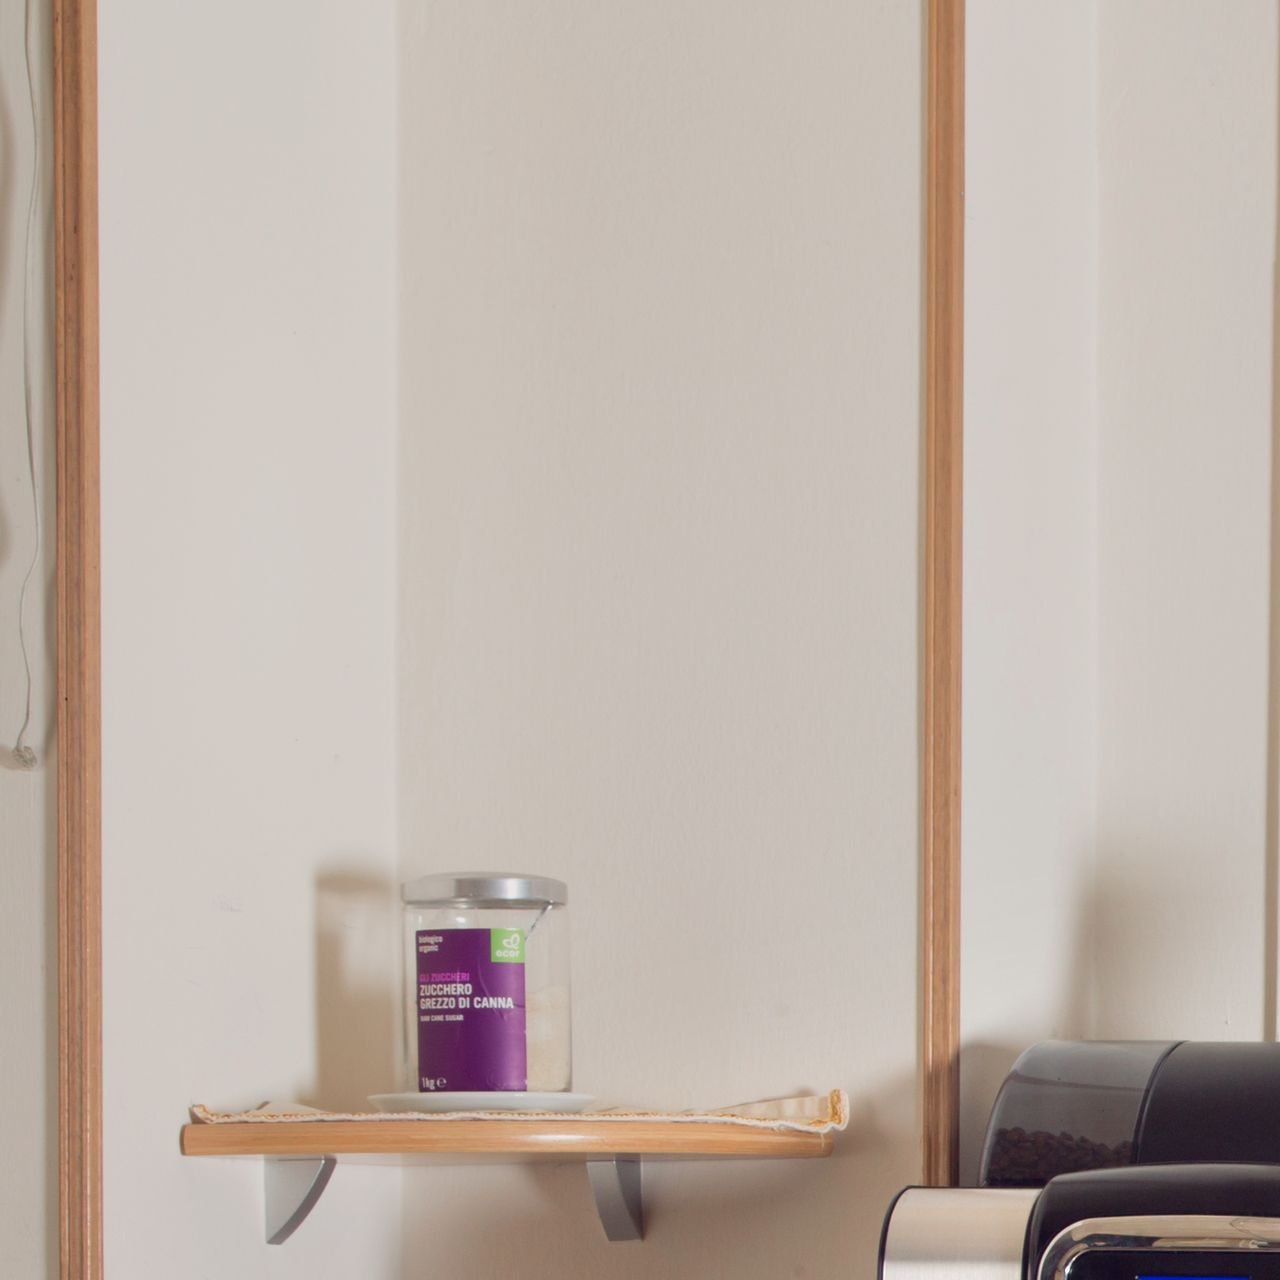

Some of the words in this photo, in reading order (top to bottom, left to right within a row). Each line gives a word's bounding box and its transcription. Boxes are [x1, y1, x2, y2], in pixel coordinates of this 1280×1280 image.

[431, 972, 470, 982] ZUCCHERI
[420, 983, 473, 996] ZUCCHERO
[420, 997, 456, 1009] GREZZO
[458, 997, 470, 1009] DI
[473, 997, 514, 1009] CANNA
